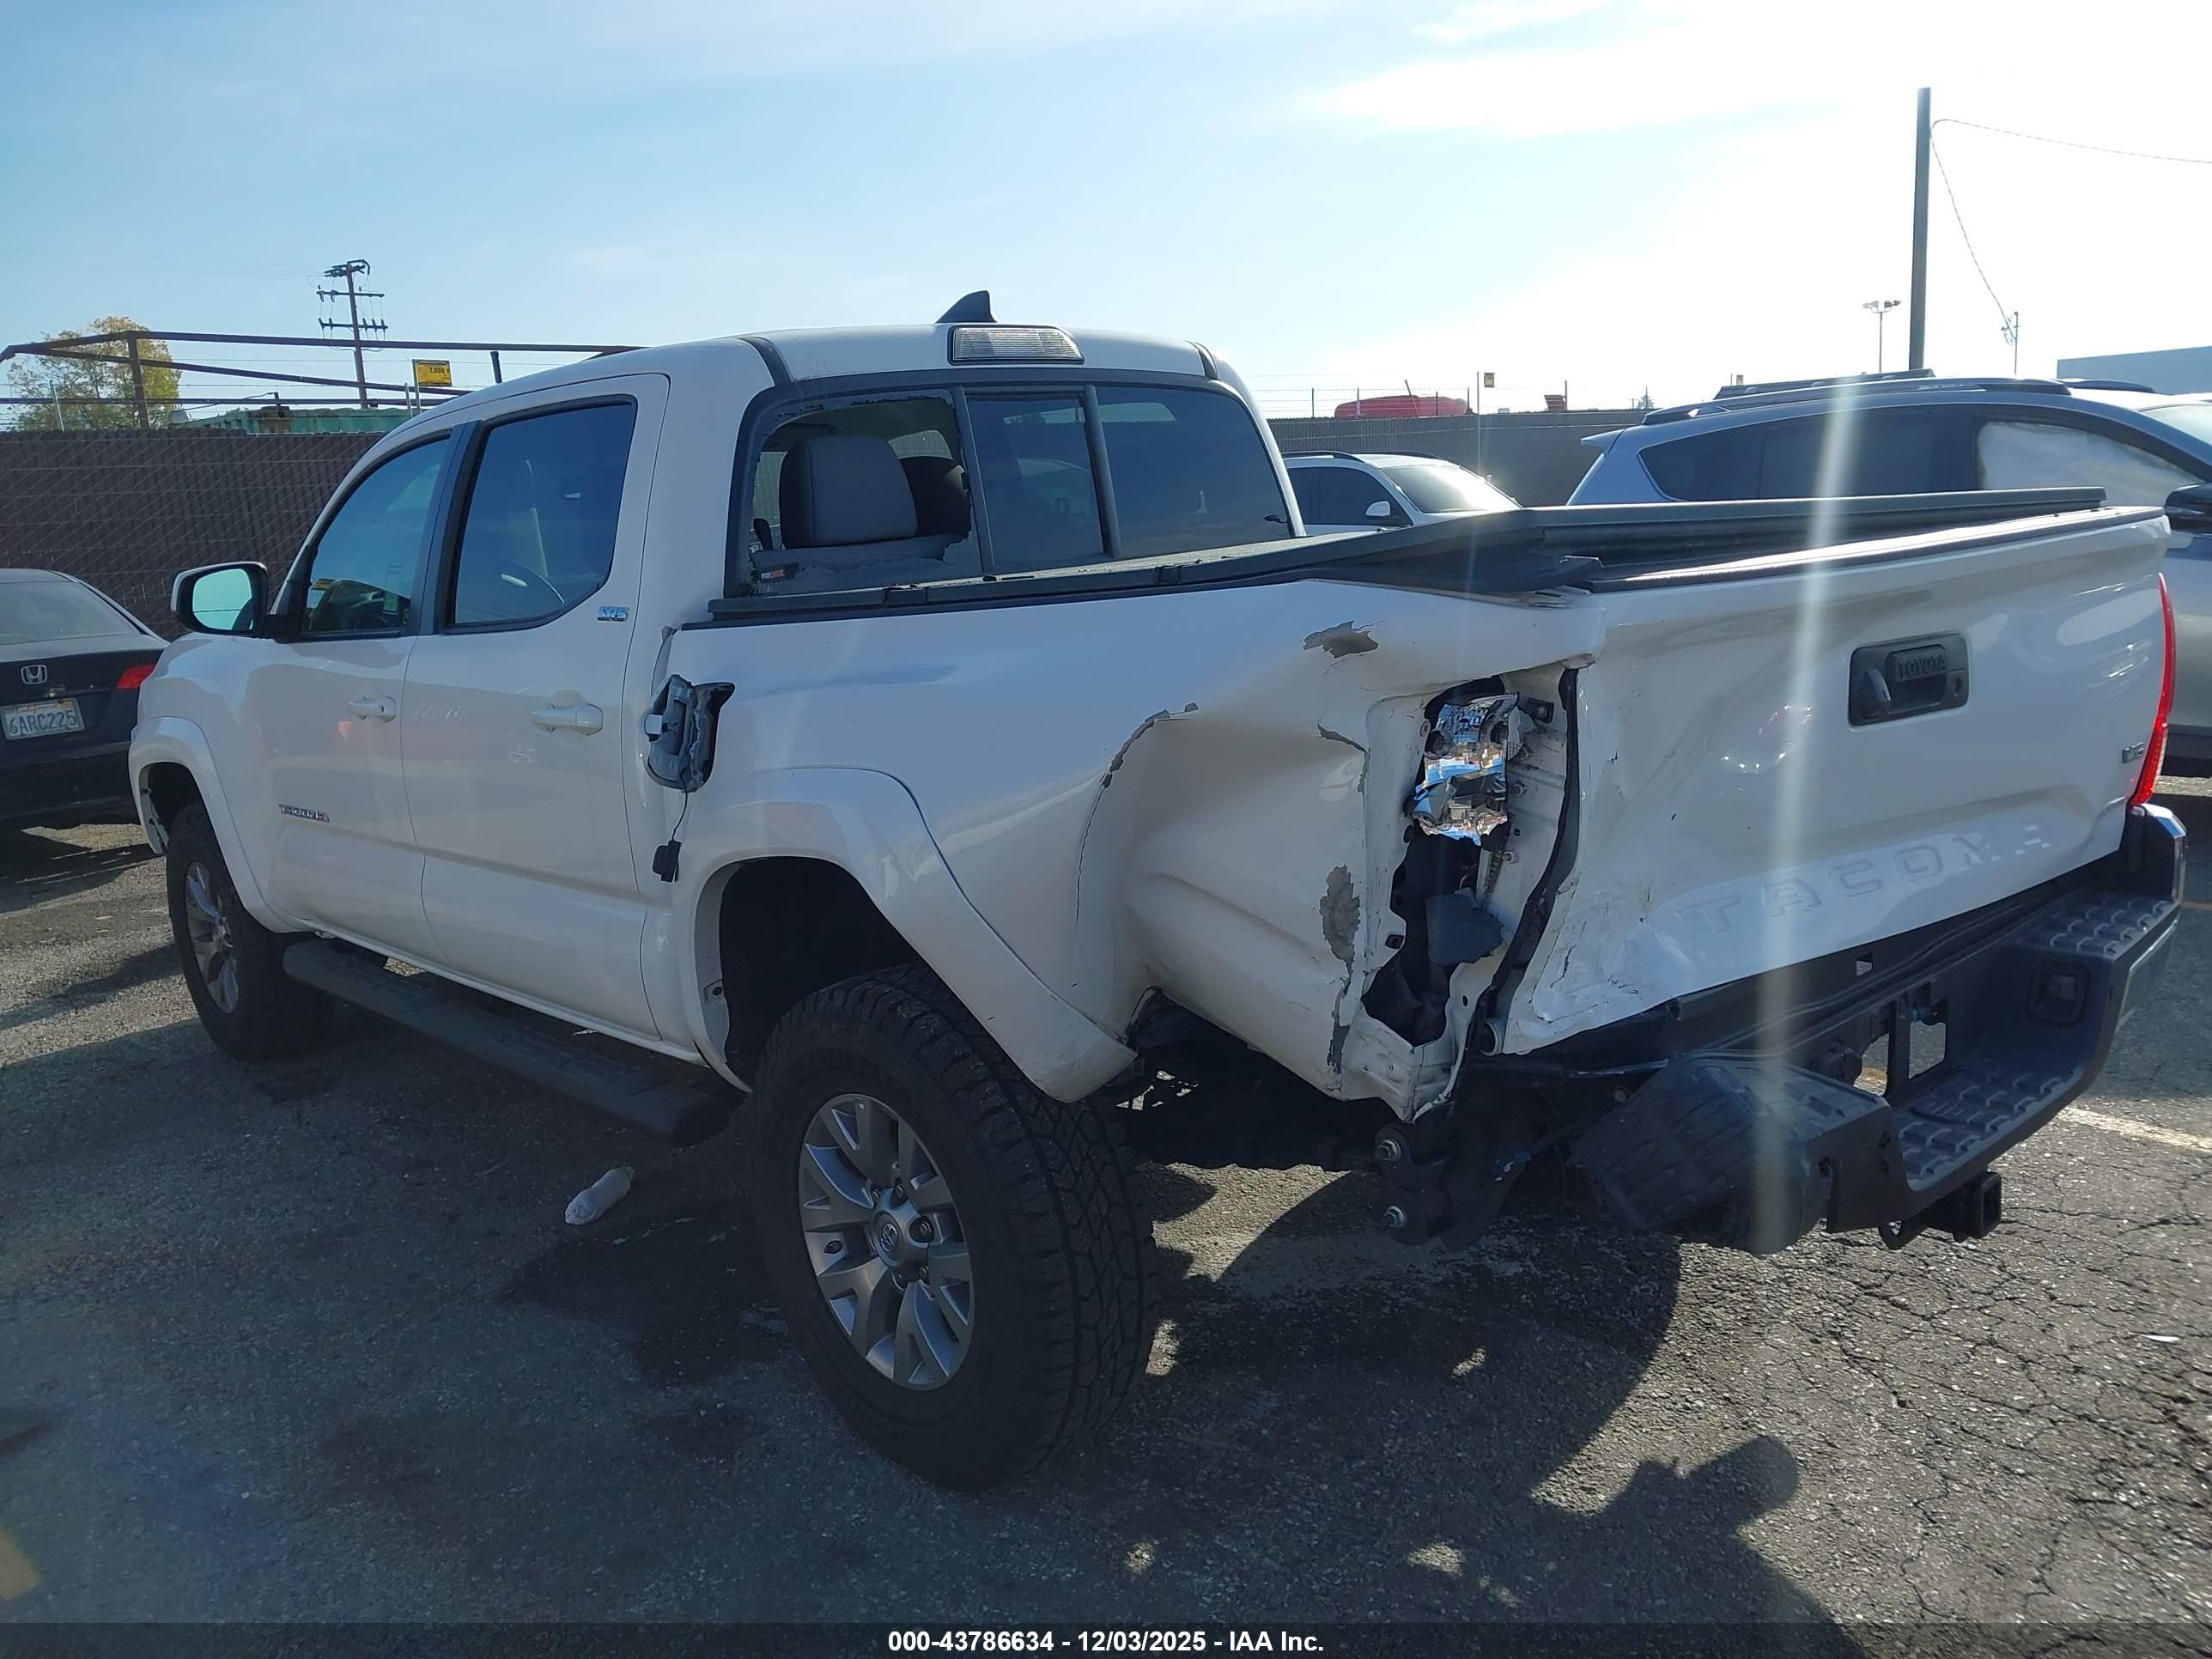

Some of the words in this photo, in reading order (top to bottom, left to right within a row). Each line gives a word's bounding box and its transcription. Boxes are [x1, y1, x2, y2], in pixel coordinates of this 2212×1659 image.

[1896, 654, 1946, 679] TOYOTA
[9, 710, 77, 736] 6ARC225
[1674, 817, 2054, 933] TACOMA
